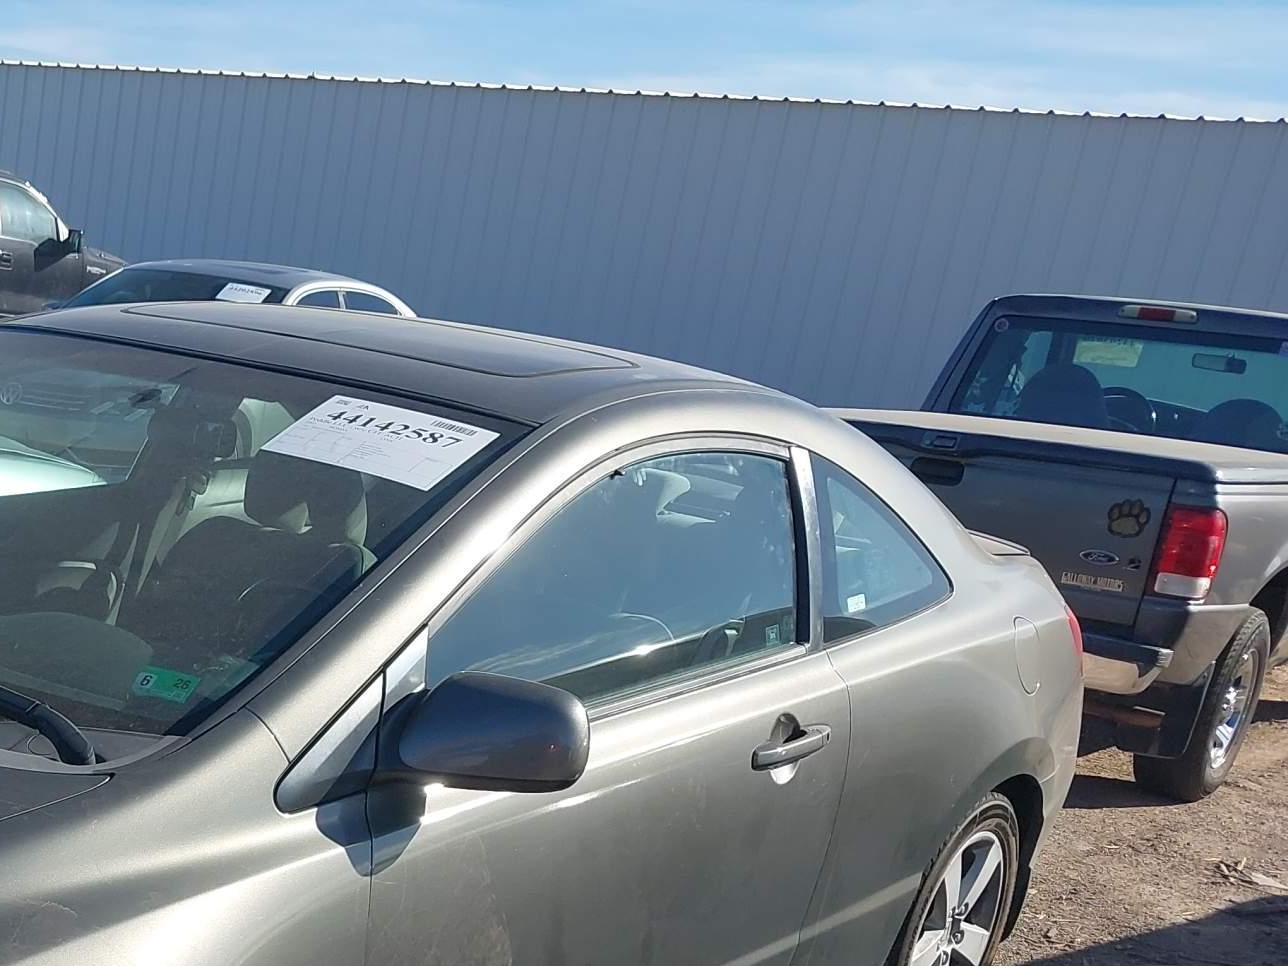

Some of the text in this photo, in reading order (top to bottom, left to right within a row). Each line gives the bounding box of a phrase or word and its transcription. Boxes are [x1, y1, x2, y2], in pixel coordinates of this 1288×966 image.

[327, 410, 463, 448] 44142587
[140, 674, 192, 690] 6 26
